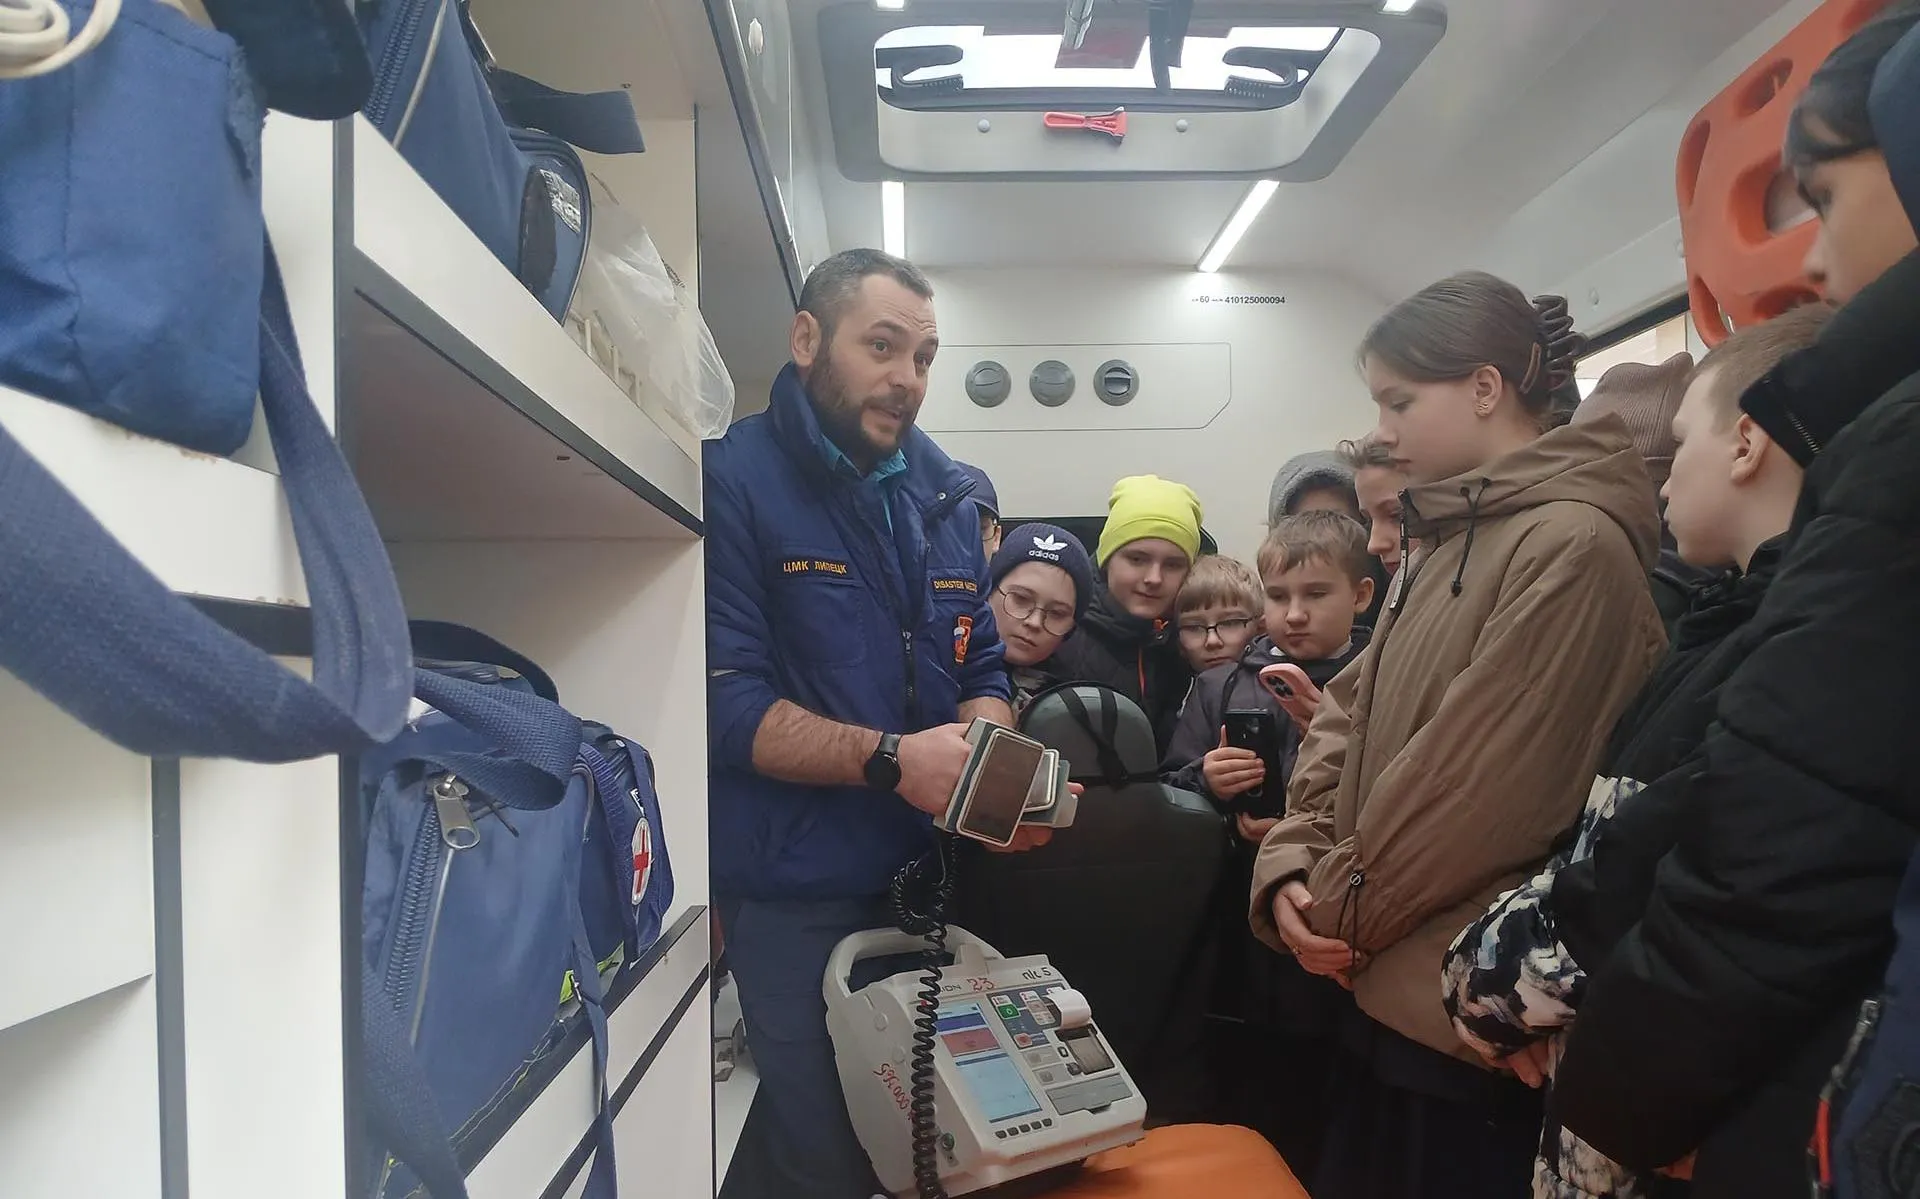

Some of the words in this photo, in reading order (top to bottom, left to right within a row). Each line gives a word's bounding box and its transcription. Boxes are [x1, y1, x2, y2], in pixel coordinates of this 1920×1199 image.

[1028, 550, 1060, 561] adidas
[783, 560, 809, 574] ЦМК
[814, 561, 848, 576] ЛИПЕЦК
[933, 580, 965, 590] DISASTER
